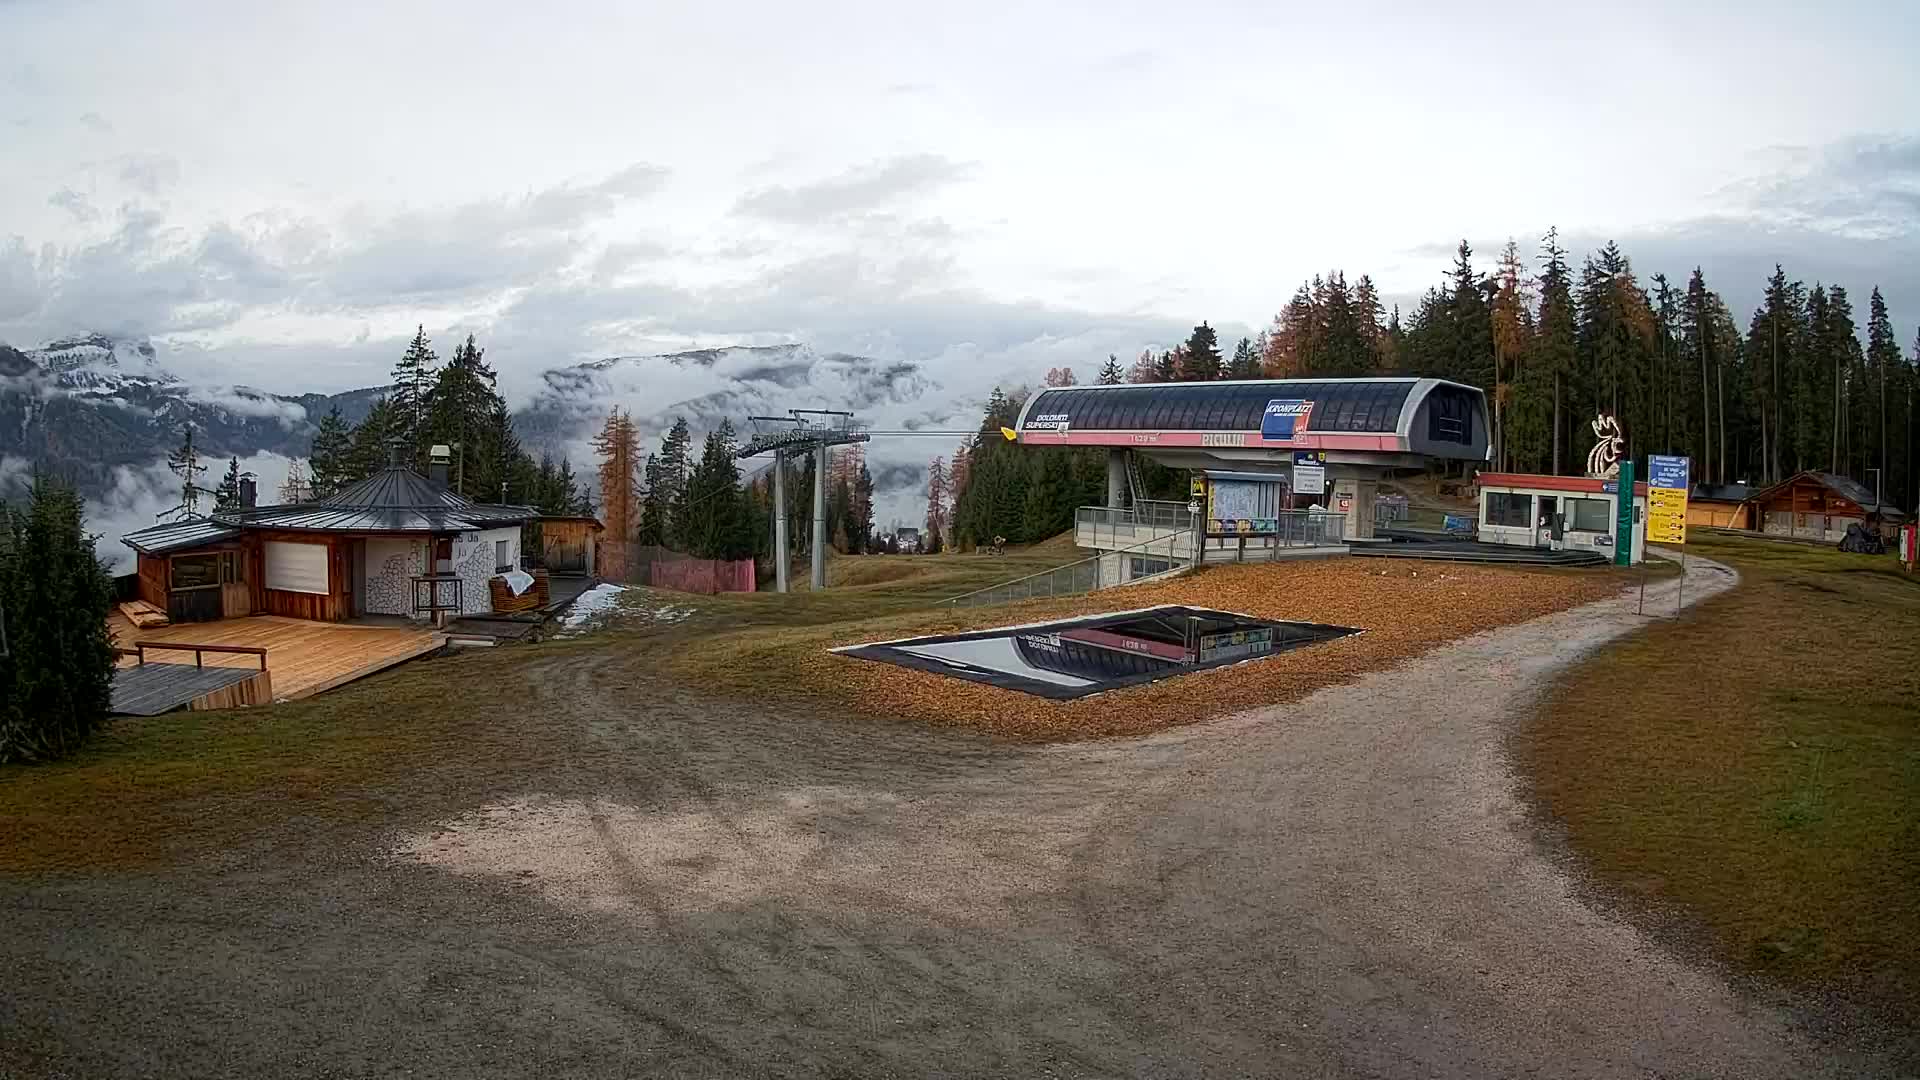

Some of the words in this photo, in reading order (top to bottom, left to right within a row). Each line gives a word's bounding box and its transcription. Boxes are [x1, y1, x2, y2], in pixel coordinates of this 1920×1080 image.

[1266, 404, 1312, 413] KRONPLATZ
[1036, 414, 1068, 422] DOLOMITI
[1025, 421, 1058, 429] SUPERSKI
